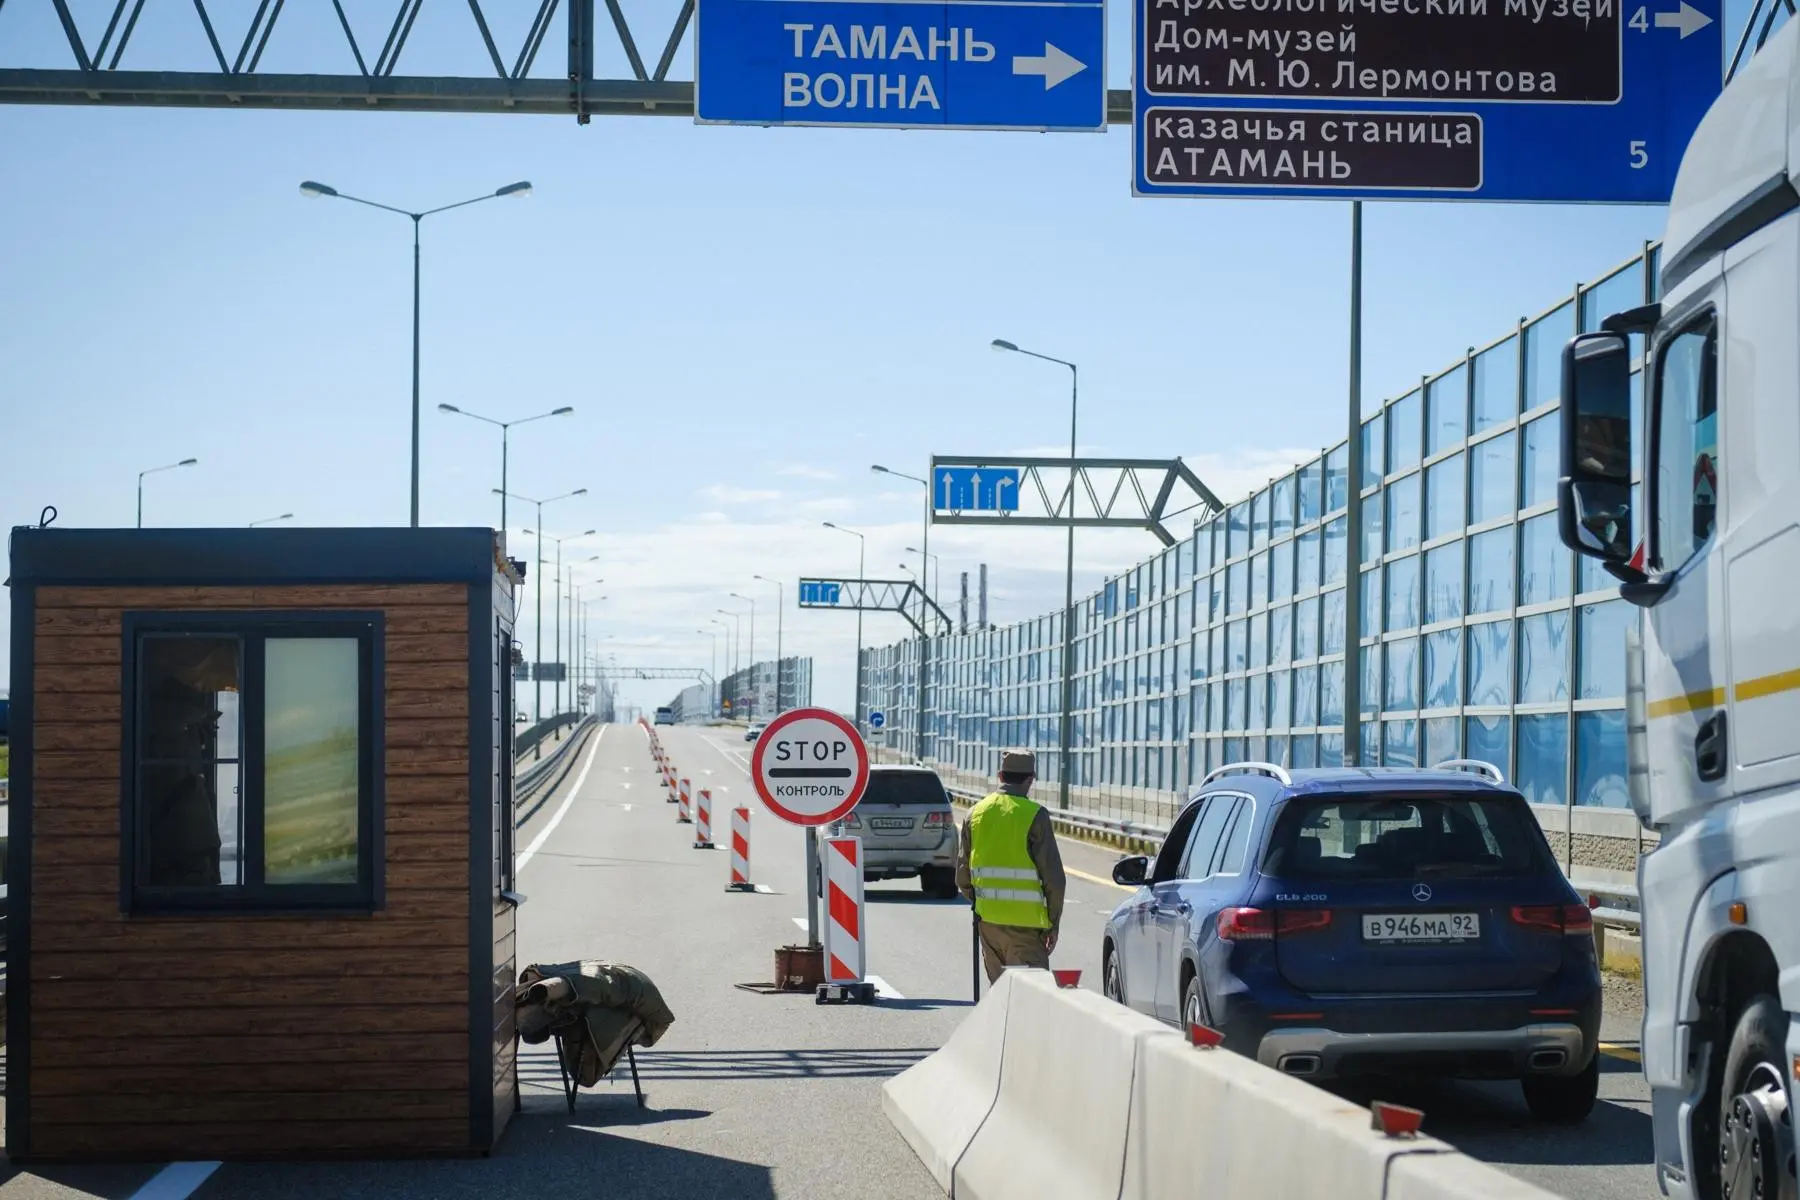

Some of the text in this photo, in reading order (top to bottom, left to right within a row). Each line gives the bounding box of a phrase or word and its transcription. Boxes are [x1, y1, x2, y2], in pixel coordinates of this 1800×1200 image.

[1504, 0, 1612, 23] музей
[1628, 6, 1650, 34] 4
[784, 23, 996, 62] ТАМАНЬ
[1155, 20, 1356, 57] Дом-музей
[784, 72, 941, 110] ВОЛНА
[1156, 58, 1557, 97] им. М. Ю. Лермонтова
[1155, 116, 1473, 150] казачья станица
[1155, 148, 1352, 179] АТАМАНЬ
[1629, 141, 1648, 169] 5
[776, 741, 846, 761] STOP
[776, 785, 845, 797] КОНТРОЛЬ
